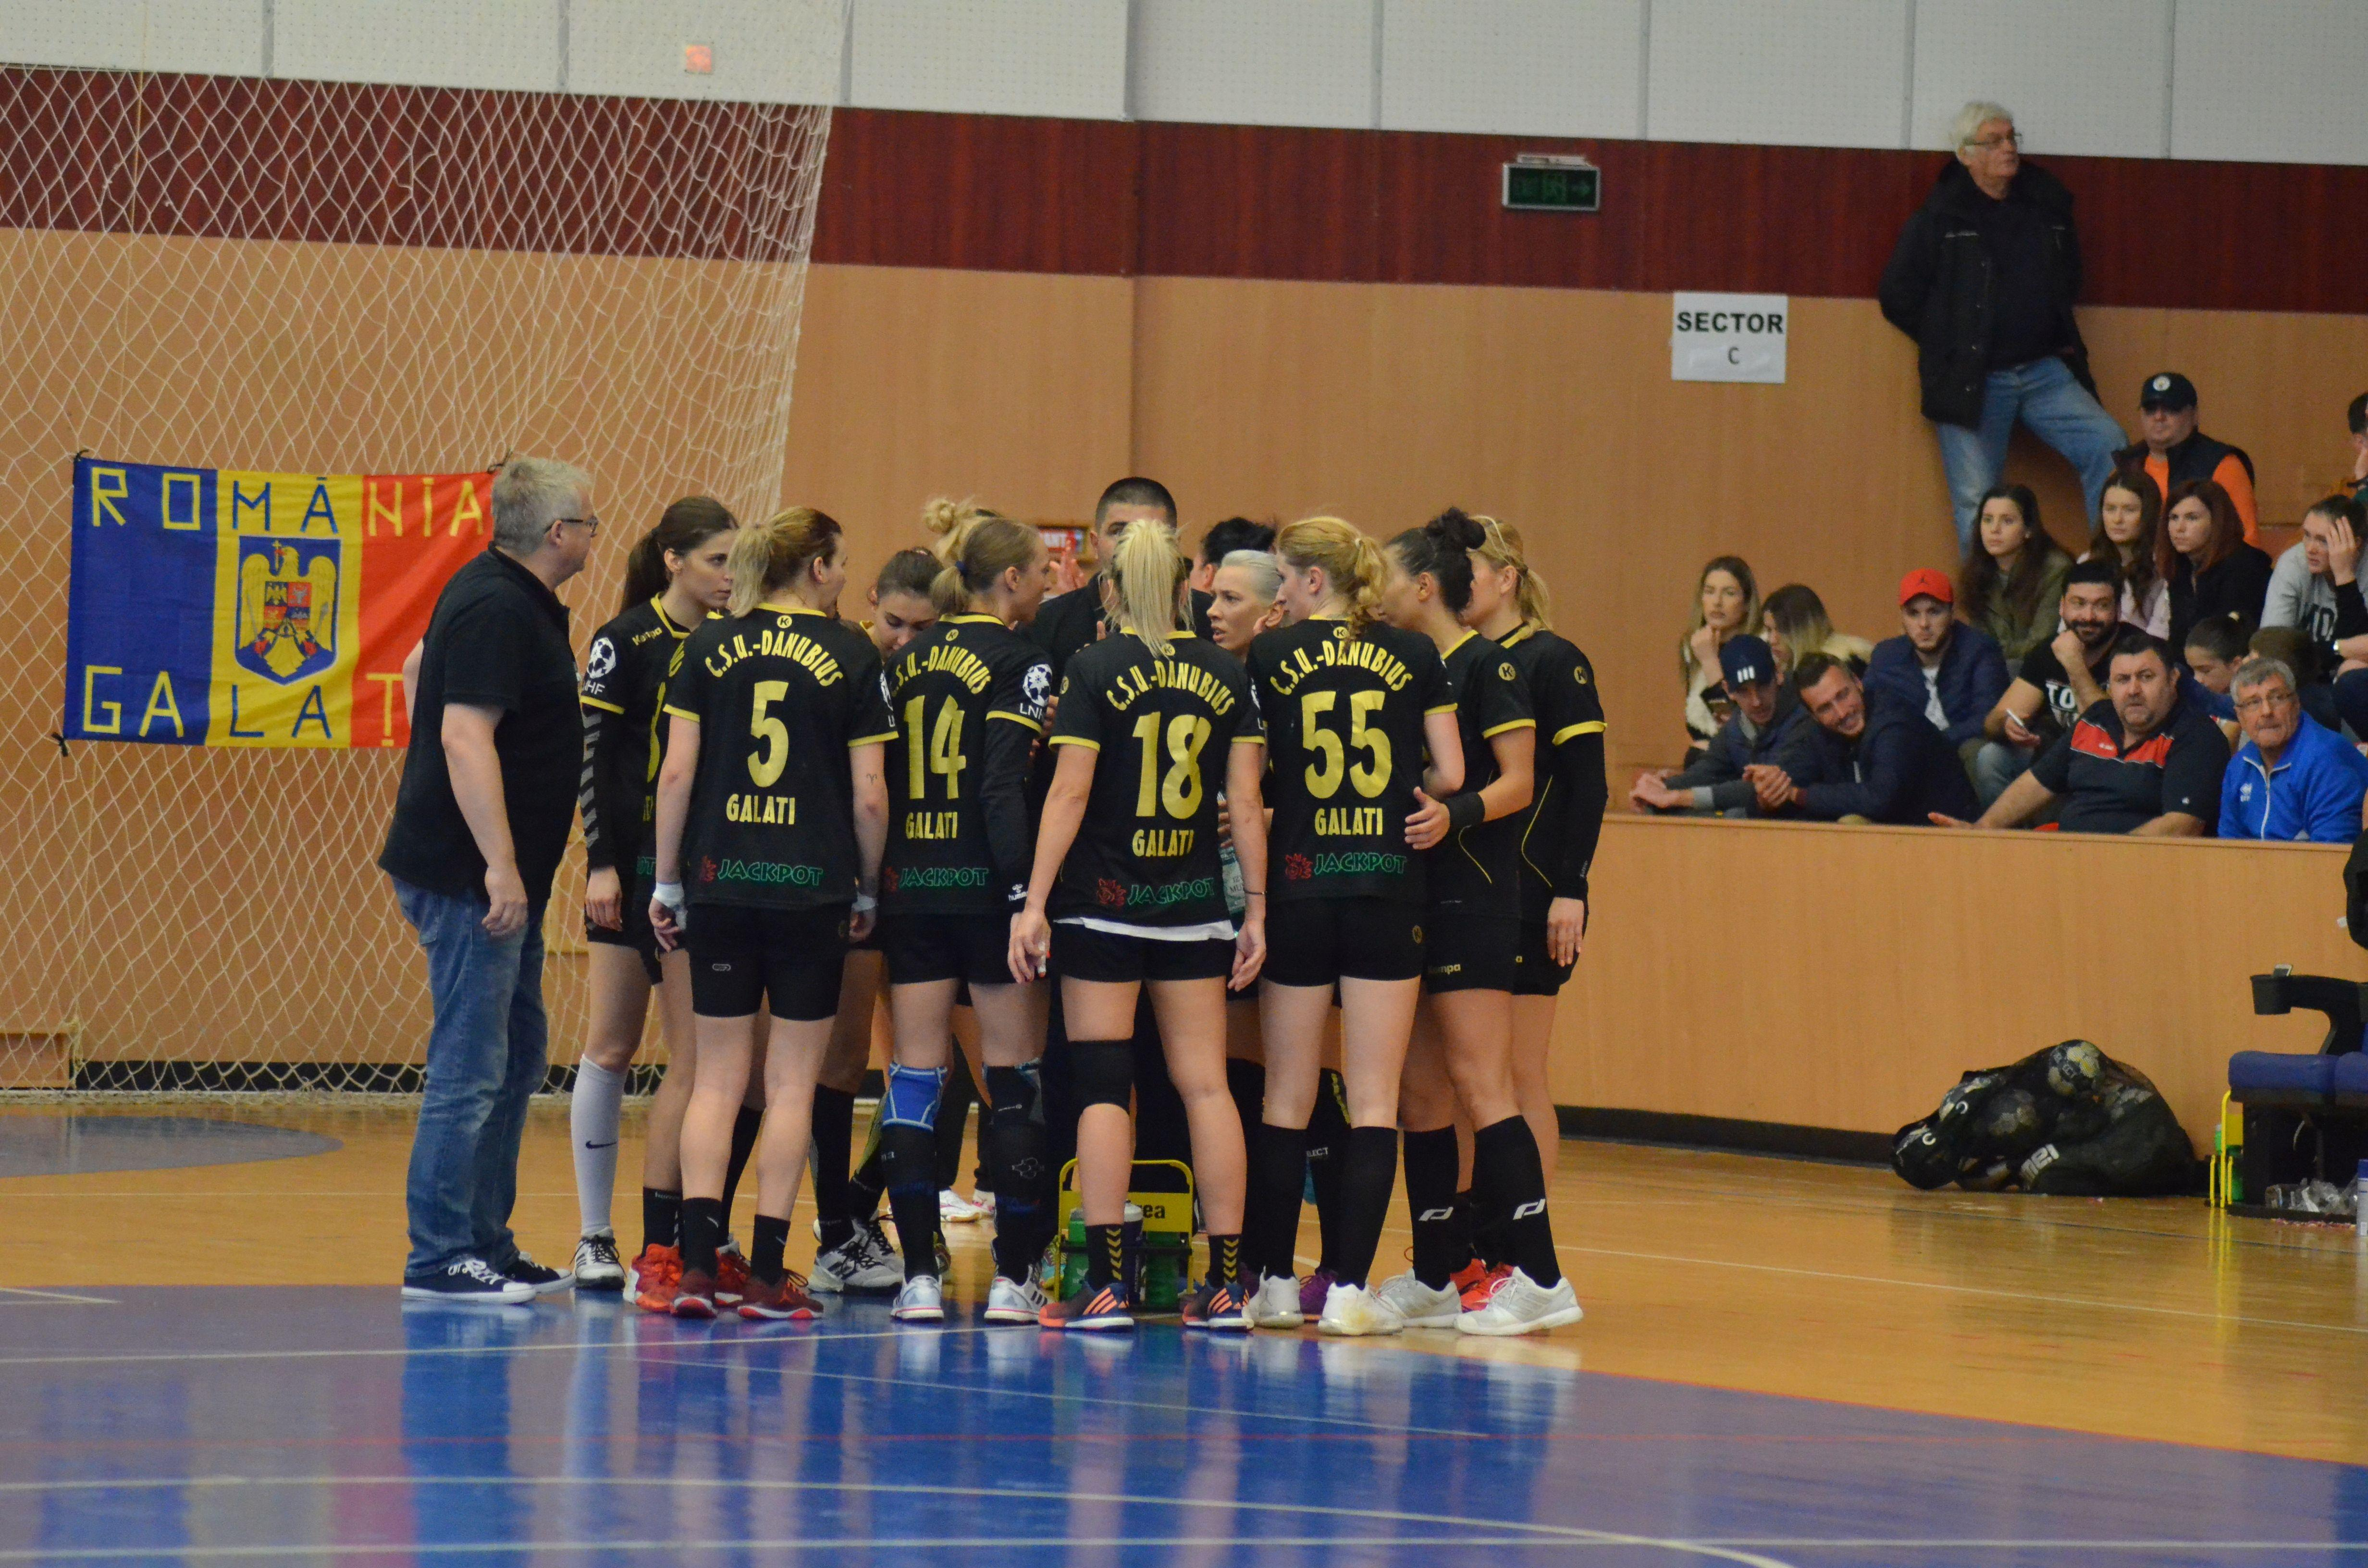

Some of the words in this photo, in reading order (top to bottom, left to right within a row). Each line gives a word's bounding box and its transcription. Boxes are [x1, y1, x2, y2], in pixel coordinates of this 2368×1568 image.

[1677, 312, 1784, 334] SECTOR
[1728, 347, 1739, 365] C
[705, 630, 843, 686] C.S.U.-DANUBIUS
[1270, 640, 1413, 696] C.S.U.-DANUBIUS
[1107, 660, 1235, 716] C.S.U.-DANUBIUS
[747, 680, 789, 788] 5
[904, 695, 967, 799] 14
[1301, 690, 1393, 799] 55
[1133, 711, 1212, 819] 18
[726, 794, 796, 825] GALATI
[1314, 807, 1383, 836] GALATI
[905, 811, 958, 839] GALATI
[1132, 829, 1194, 858] GALATI
[717, 858, 824, 886] JACKPOT
[899, 867, 989, 888] JACKPOT
[1314, 851, 1407, 875] JACKPOT
[1127, 878, 1215, 907] JACKPOT
